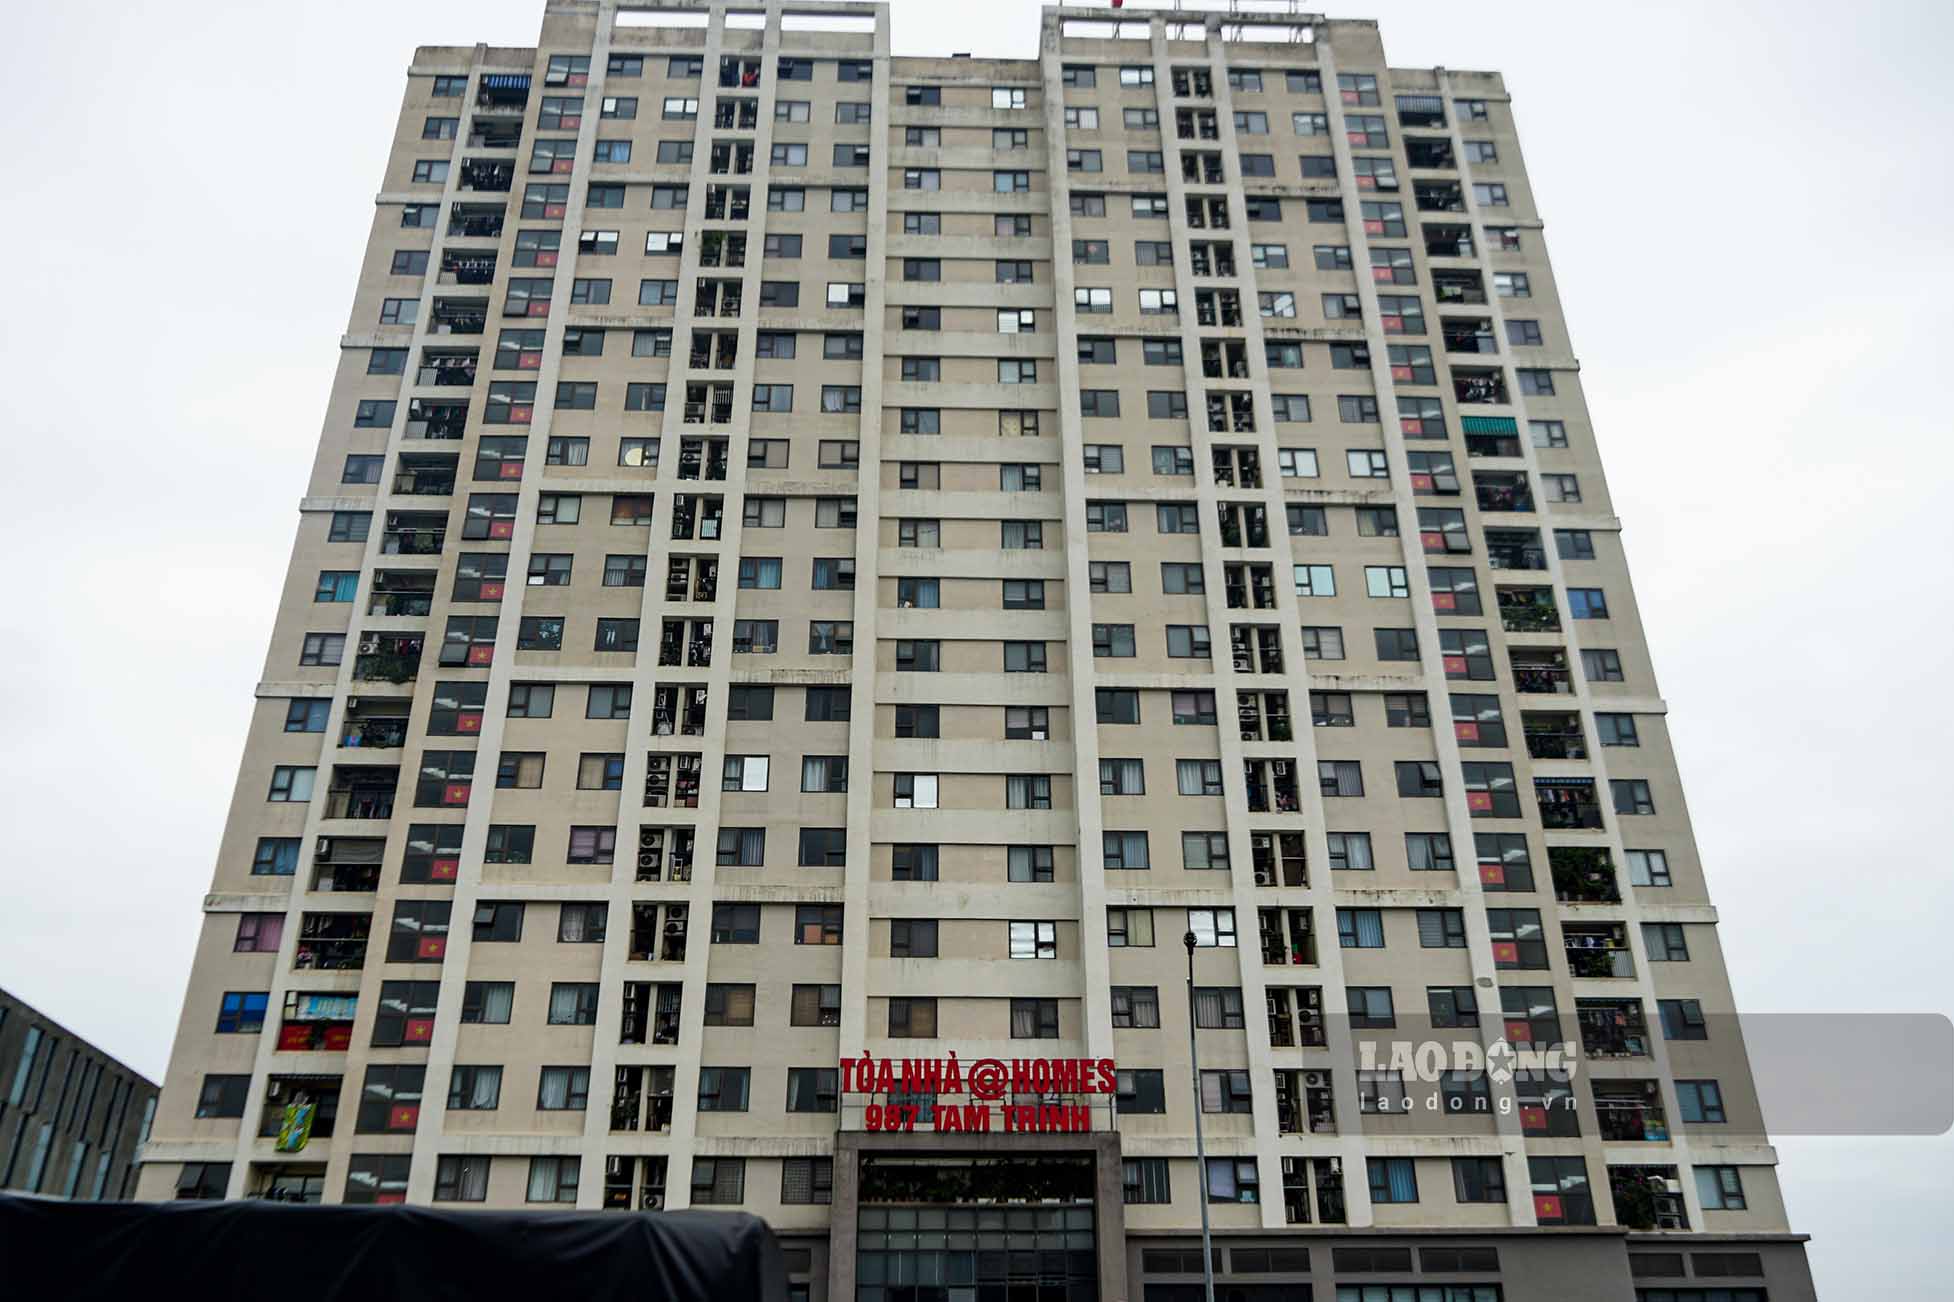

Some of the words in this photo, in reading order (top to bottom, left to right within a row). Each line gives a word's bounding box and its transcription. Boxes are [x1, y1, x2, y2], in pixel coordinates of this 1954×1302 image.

[840, 1050, 895, 1093] TÒA
[901, 1050, 964, 1093] NHÀ
[865, 1104, 921, 1132] 987
[931, 1104, 990, 1133] TAM
[1001, 1104, 1091, 1133] TRINH
